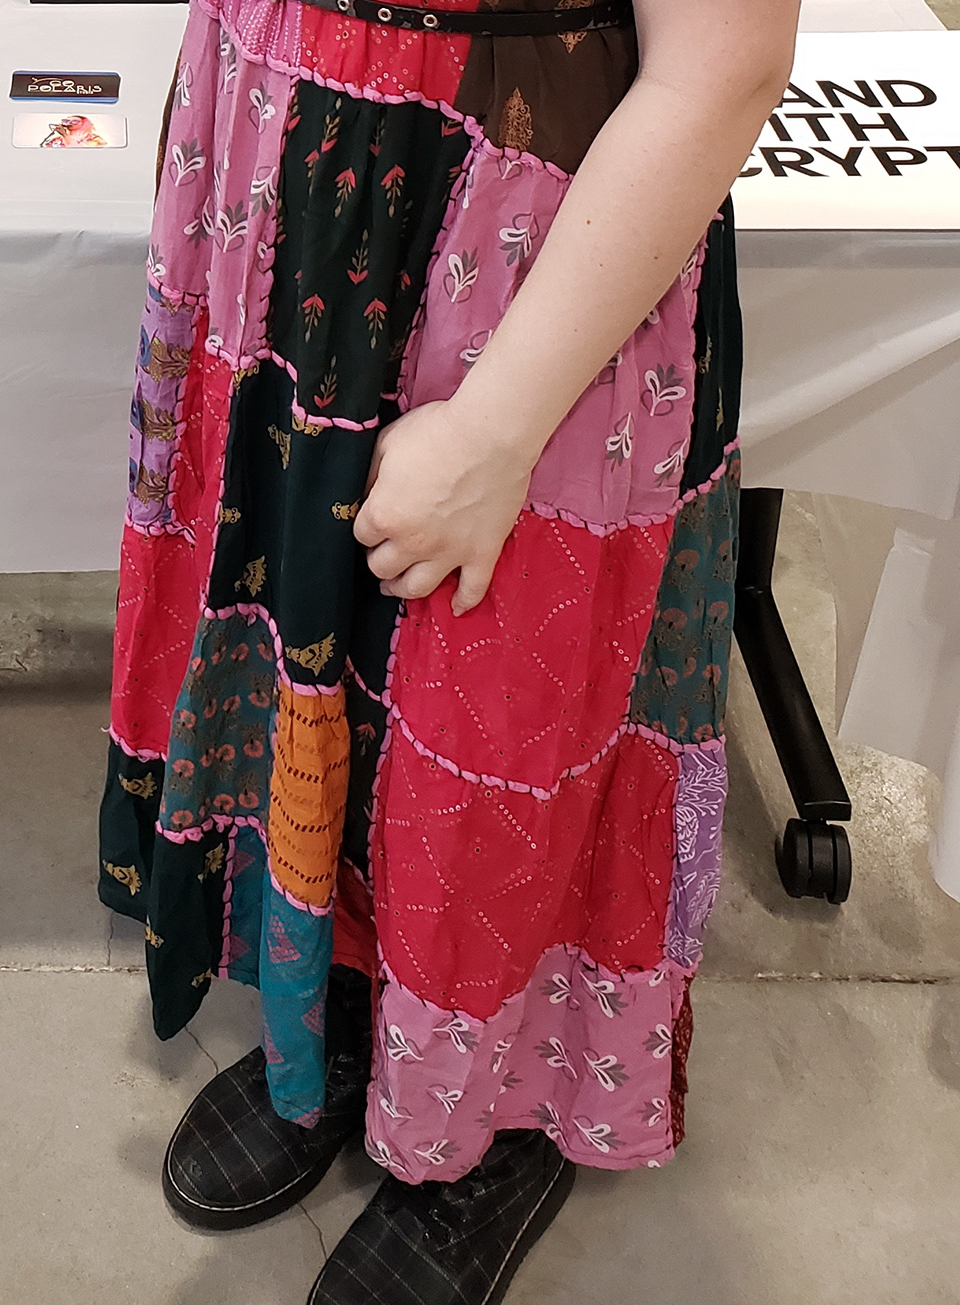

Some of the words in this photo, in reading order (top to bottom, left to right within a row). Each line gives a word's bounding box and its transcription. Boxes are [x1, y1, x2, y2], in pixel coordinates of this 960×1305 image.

[27, 84, 102, 94] POLARIS
[773, 79, 938, 108] AND
[766, 112, 909, 142] ITH
[736, 145, 960, 177] RYPT
